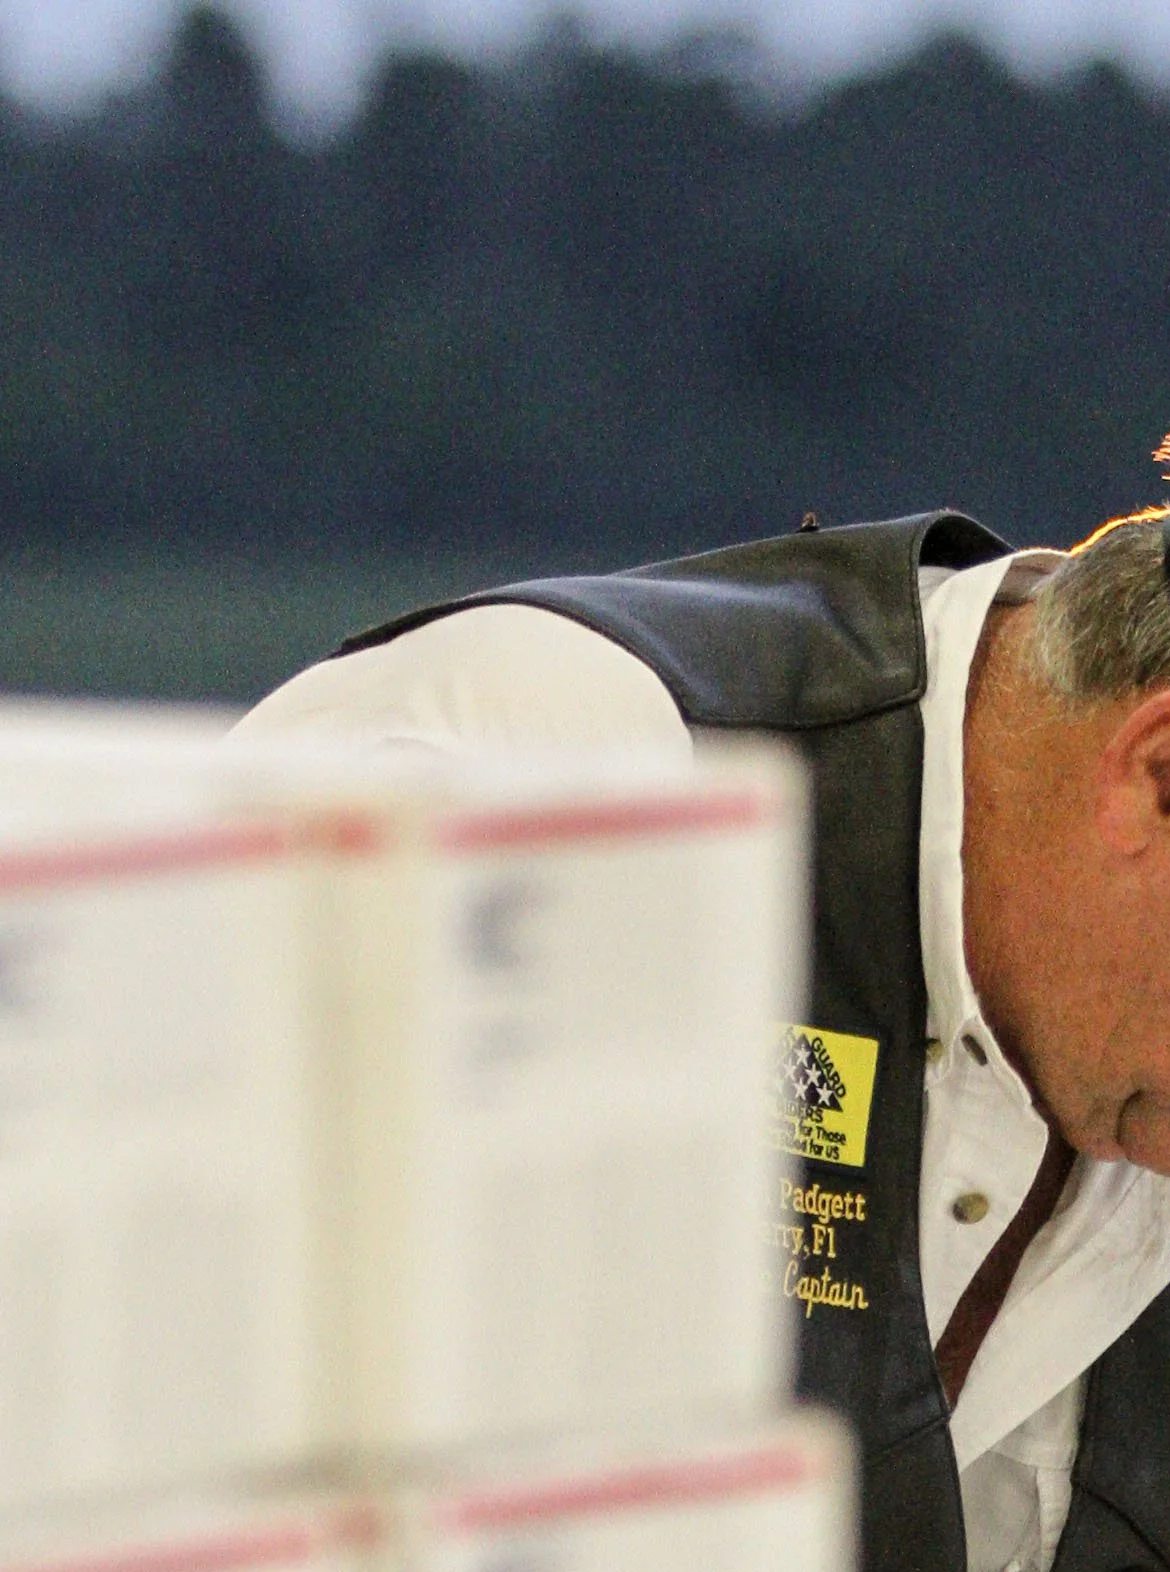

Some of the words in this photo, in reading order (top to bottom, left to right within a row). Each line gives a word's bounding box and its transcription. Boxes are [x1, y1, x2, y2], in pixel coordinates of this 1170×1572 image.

[811, 1036, 847, 1099] GUARD
[809, 1139, 824, 1156] for
[825, 1145, 840, 1160] US
[815, 1125, 847, 1146] Those
[779, 1177, 867, 1224] Padgett
[783, 1259, 869, 1320] Captain
